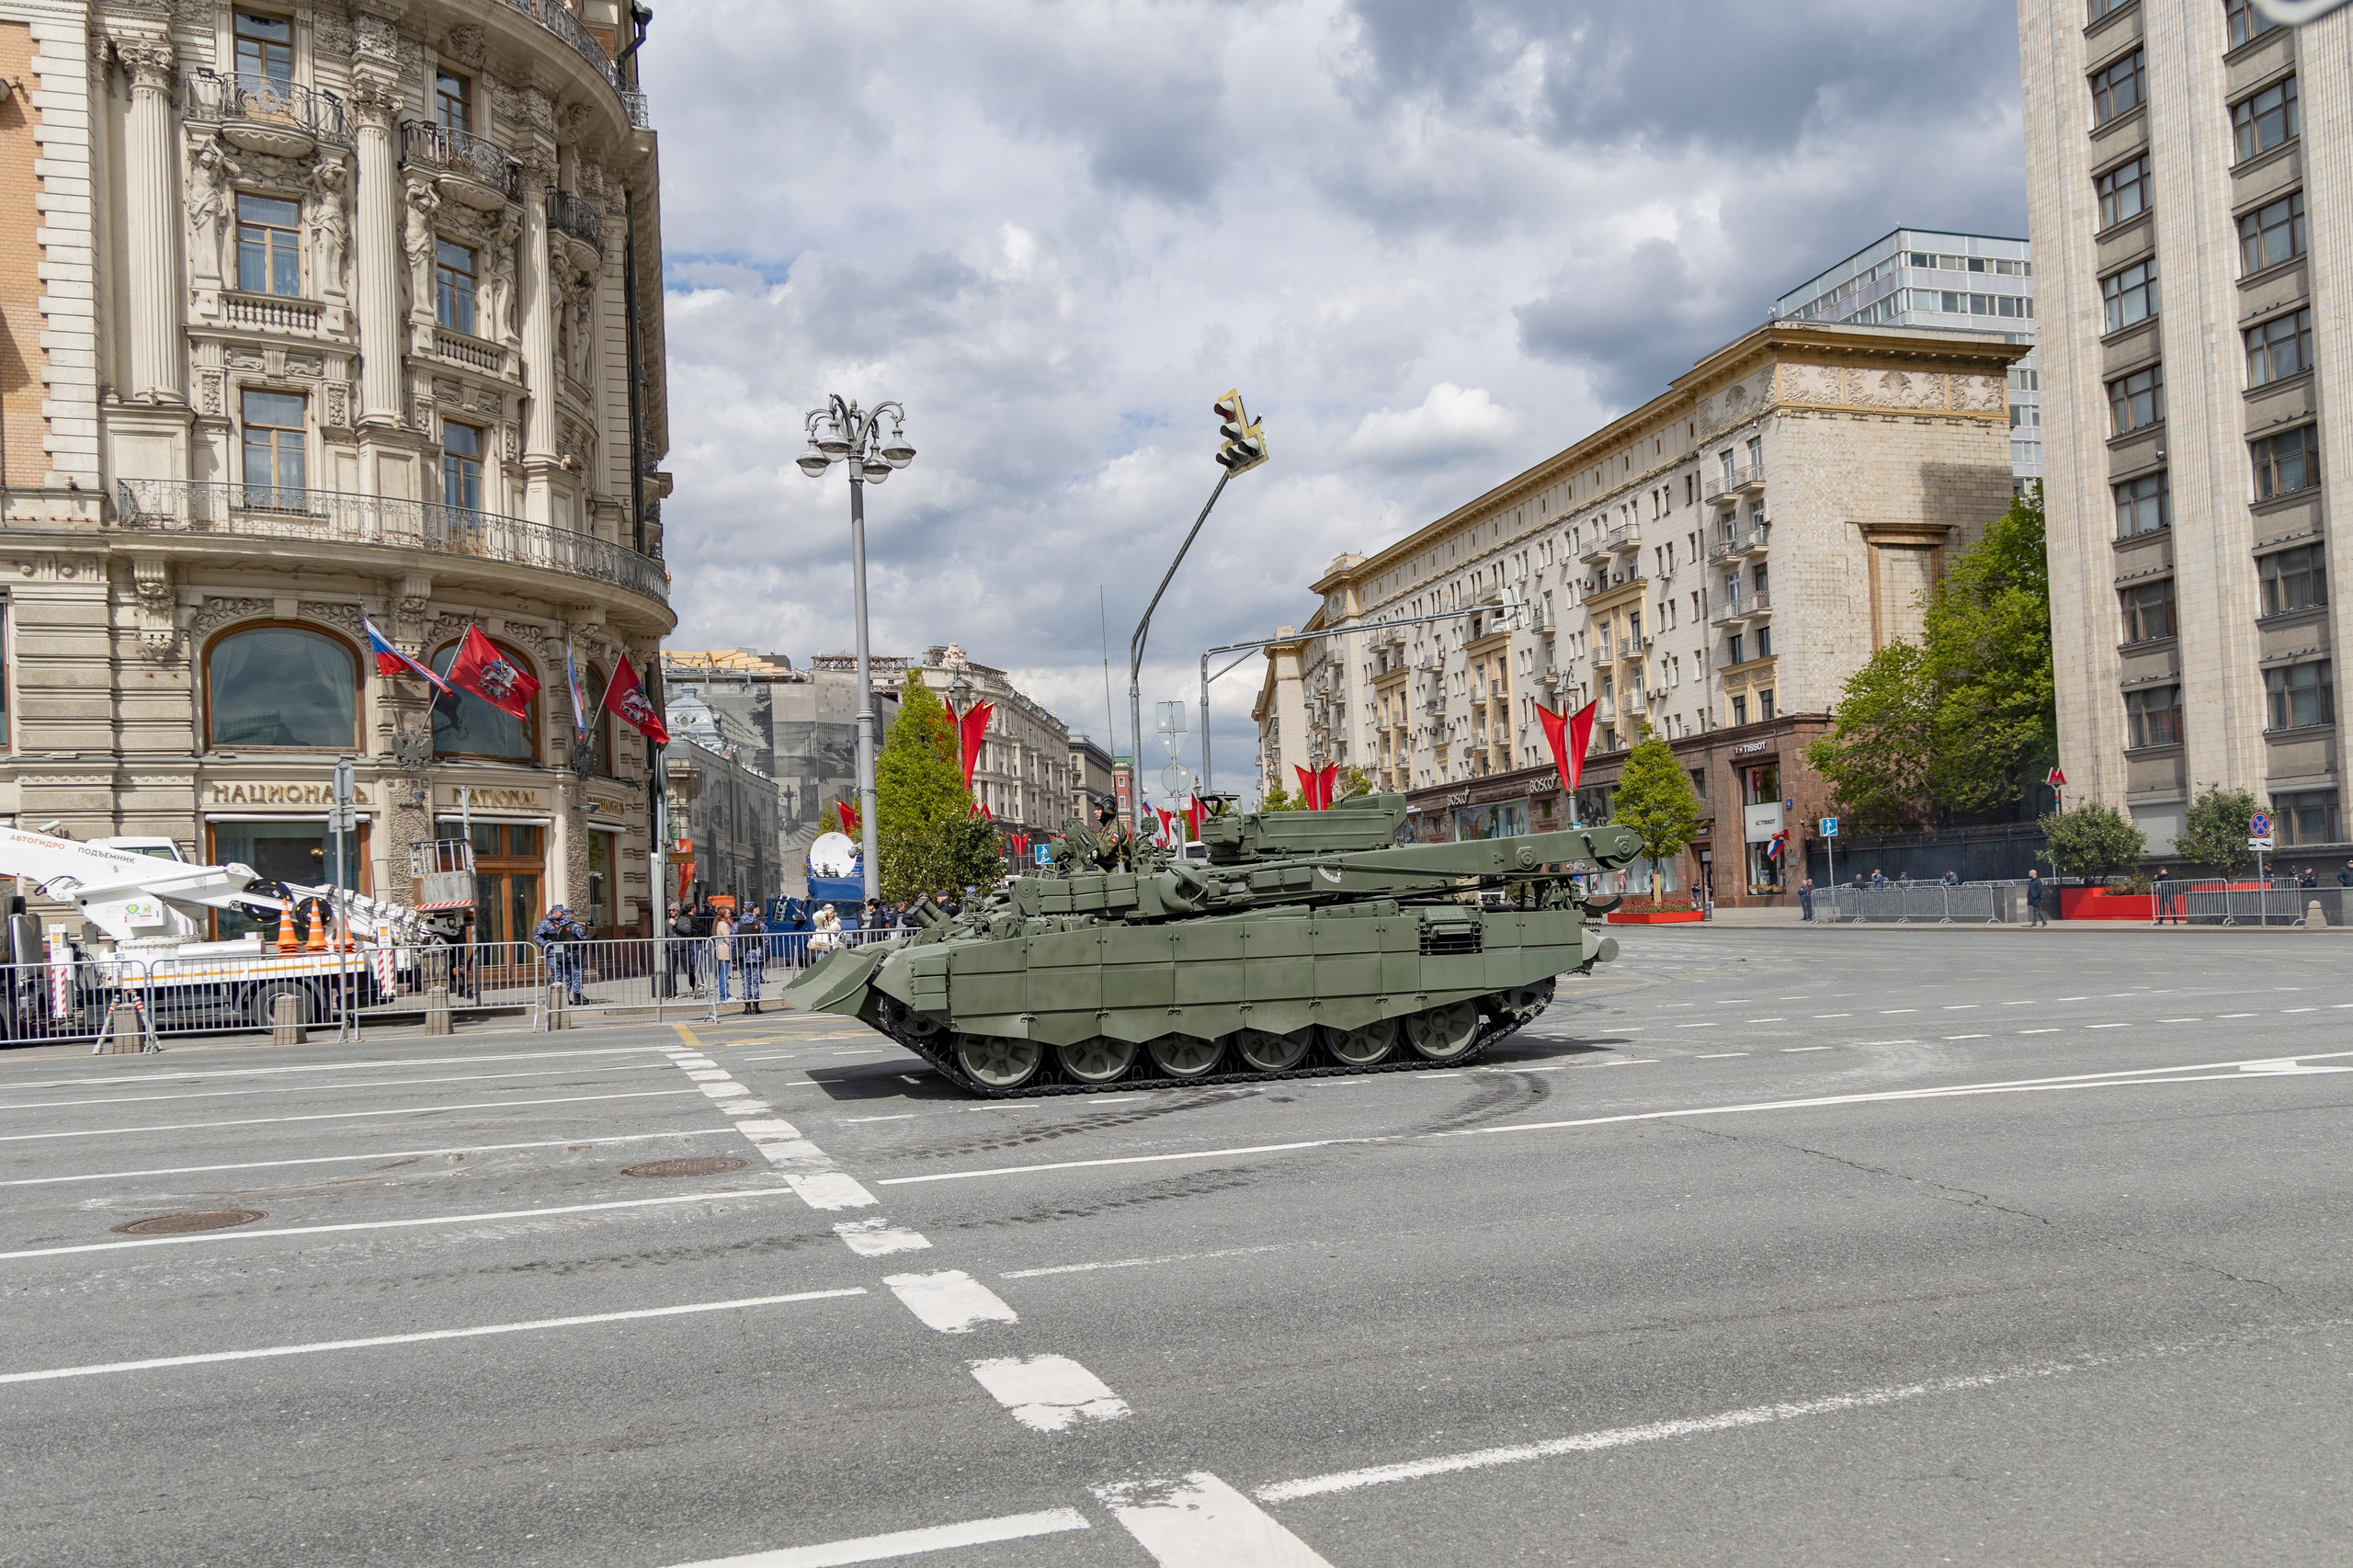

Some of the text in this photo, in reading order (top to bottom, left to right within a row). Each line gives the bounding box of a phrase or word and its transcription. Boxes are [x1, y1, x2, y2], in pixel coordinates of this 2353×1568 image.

[1743, 741, 1767, 753] TISSOT
[1529, 777, 1554, 792] BOSCO
[212, 784, 369, 804] НАЦИОНАЬ
[452, 788, 541, 806] NATIONAL
[1447, 792, 1467, 806] BOSCO
[9, 835, 136, 865] АВТОГИДРО ПОДЪЕМНИК
